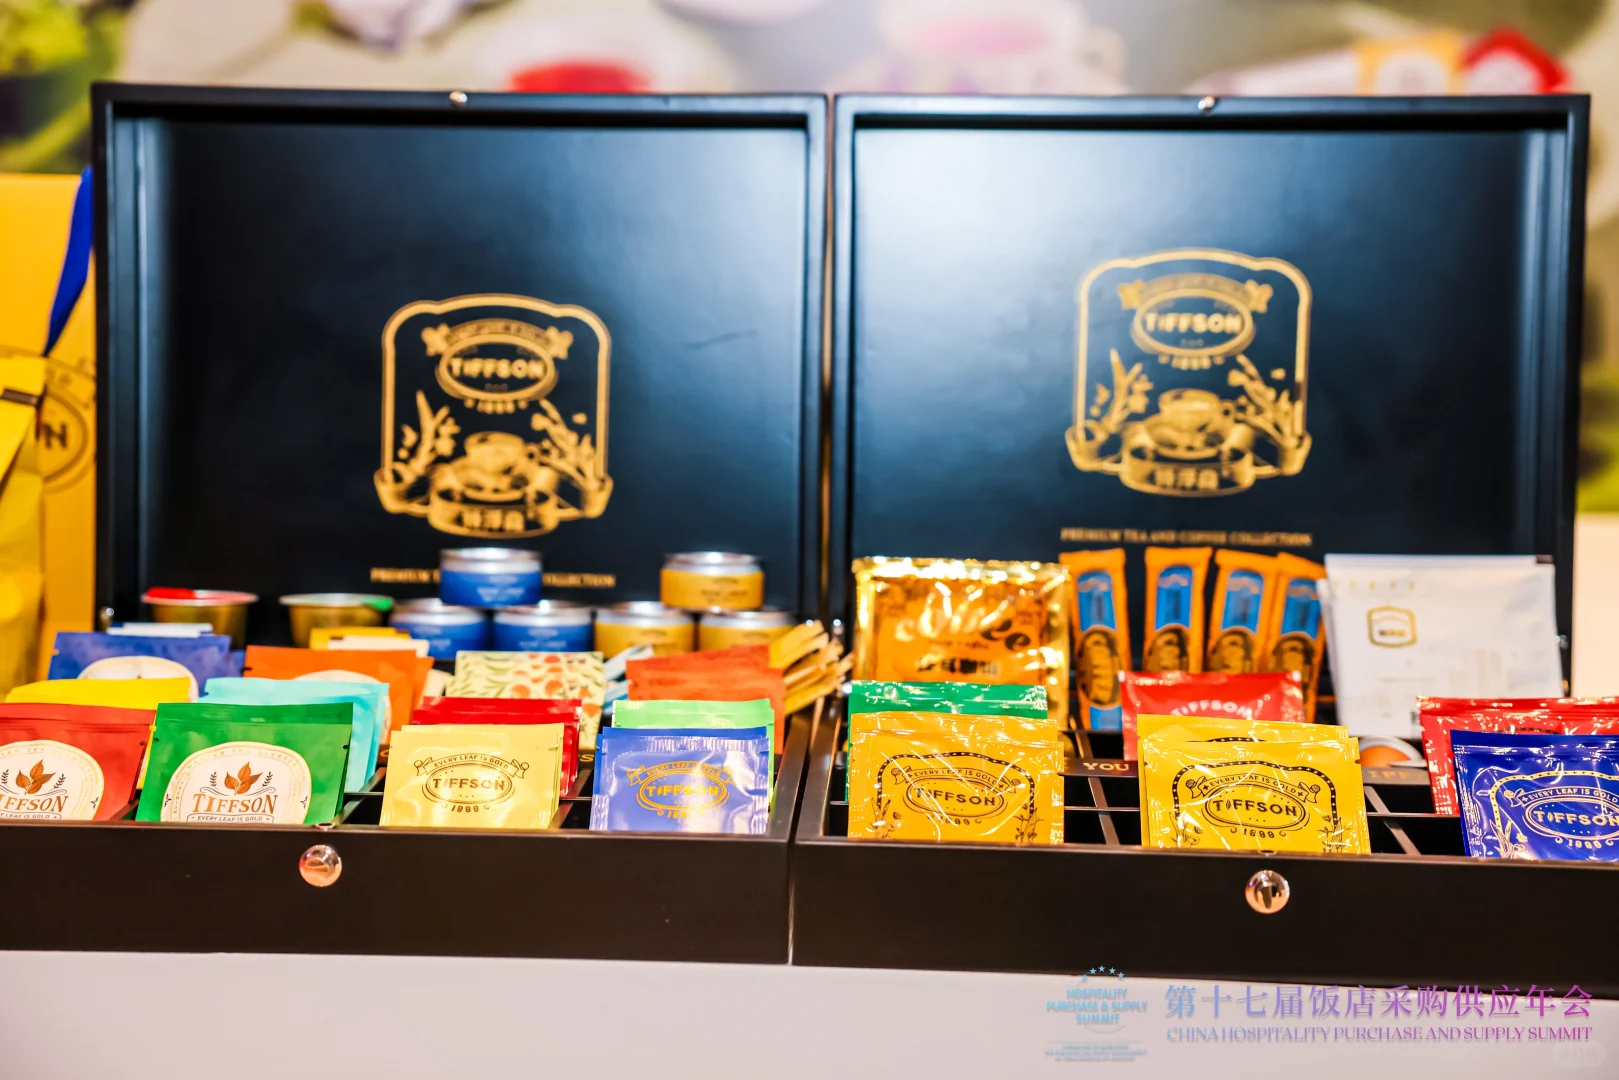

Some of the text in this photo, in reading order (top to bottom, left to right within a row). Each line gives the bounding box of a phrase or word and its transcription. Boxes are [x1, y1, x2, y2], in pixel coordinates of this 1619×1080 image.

[1146, 313, 1242, 333] TIFFSON
[451, 358, 543, 378] TIFFSON
[434, 757, 457, 767] EVERY
[490, 757, 509, 769] GOLD
[1083, 762, 1129, 772] YOU
[433, 778, 505, 790] TIFFSON
[913, 769, 939, 777] EVERY
[975, 772, 997, 785] GOLD
[1209, 777, 1235, 787] EVERY
[1273, 781, 1297, 793] GOLD
[646, 784, 719, 797] TIFFSON
[914, 788, 996, 806] TIFFSON
[1528, 790, 1553, 800] EVERY
[1593, 790, 1618, 803] GOLD
[193, 793, 278, 814] TIFFSON
[1213, 798, 1298, 817] TIFFSON
[1533, 811, 1619, 826] TIFFSON
